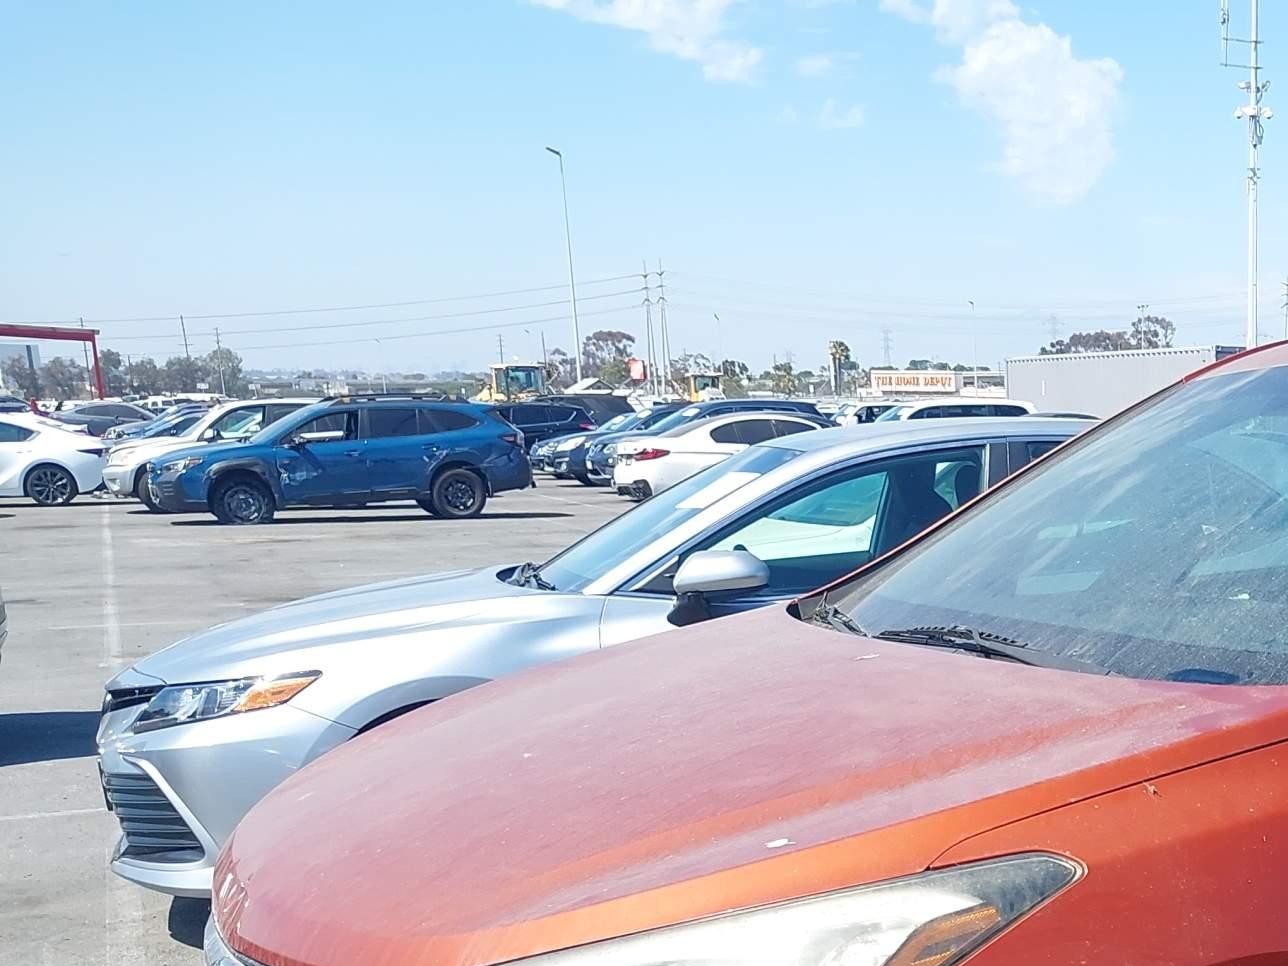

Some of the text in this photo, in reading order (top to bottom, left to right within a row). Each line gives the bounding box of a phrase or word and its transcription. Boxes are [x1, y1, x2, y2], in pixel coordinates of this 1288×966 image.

[875, 375, 952, 388] THE HOME DEPOT
